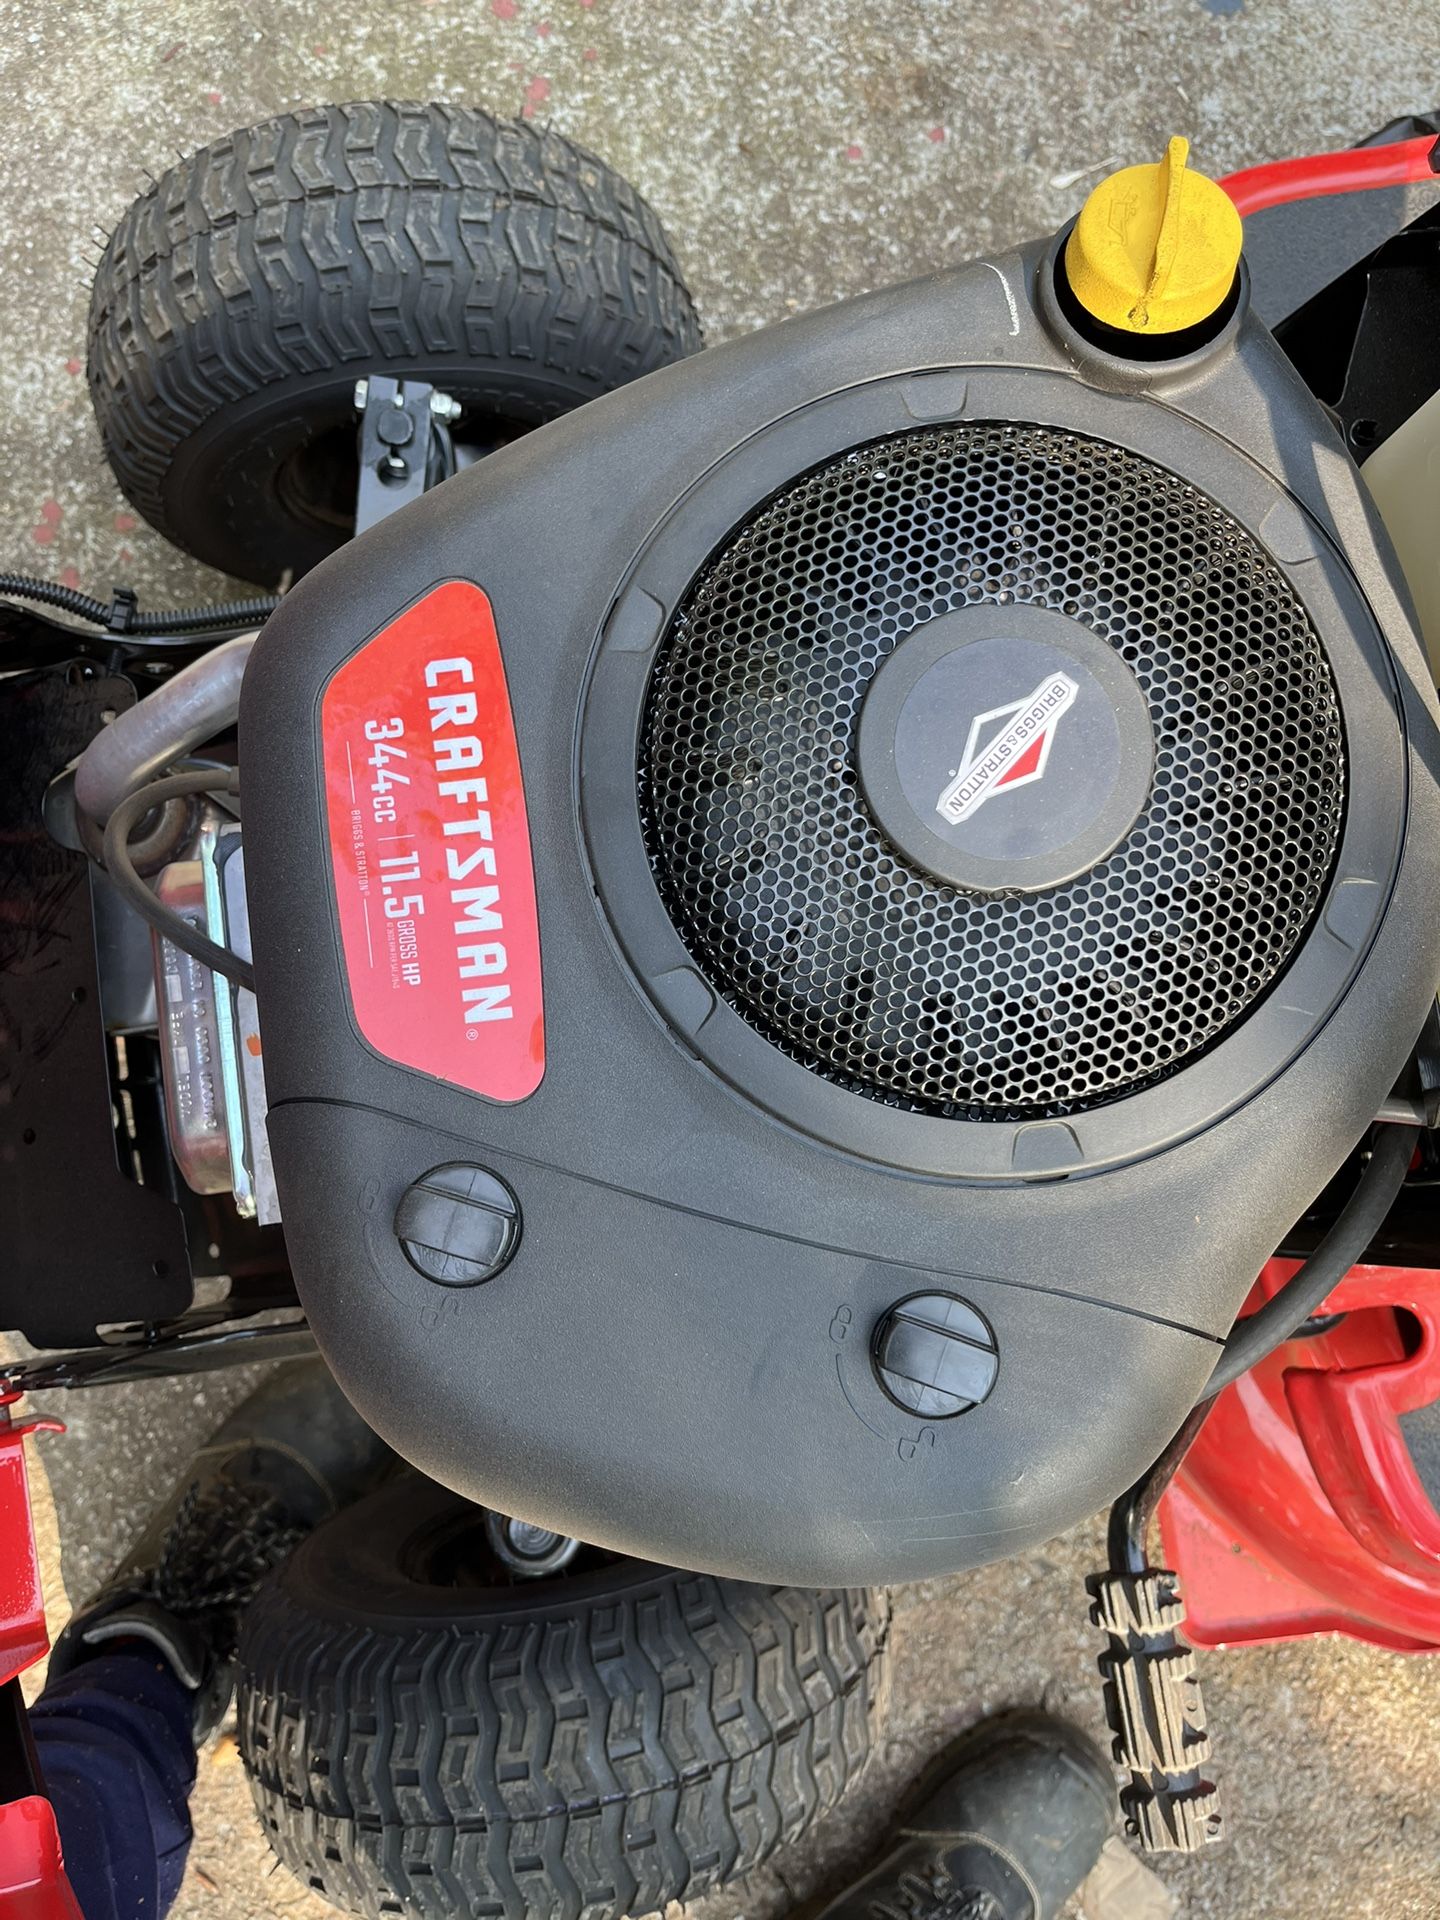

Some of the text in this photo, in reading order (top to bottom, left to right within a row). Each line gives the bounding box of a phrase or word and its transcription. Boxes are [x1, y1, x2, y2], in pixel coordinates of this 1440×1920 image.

[351, 809, 369, 891] BRIGGS & STRATTON
[364, 717, 425, 986] 344cc 11.5 GROSS HP
[425, 657, 513, 1024] CRAFTSMAN
